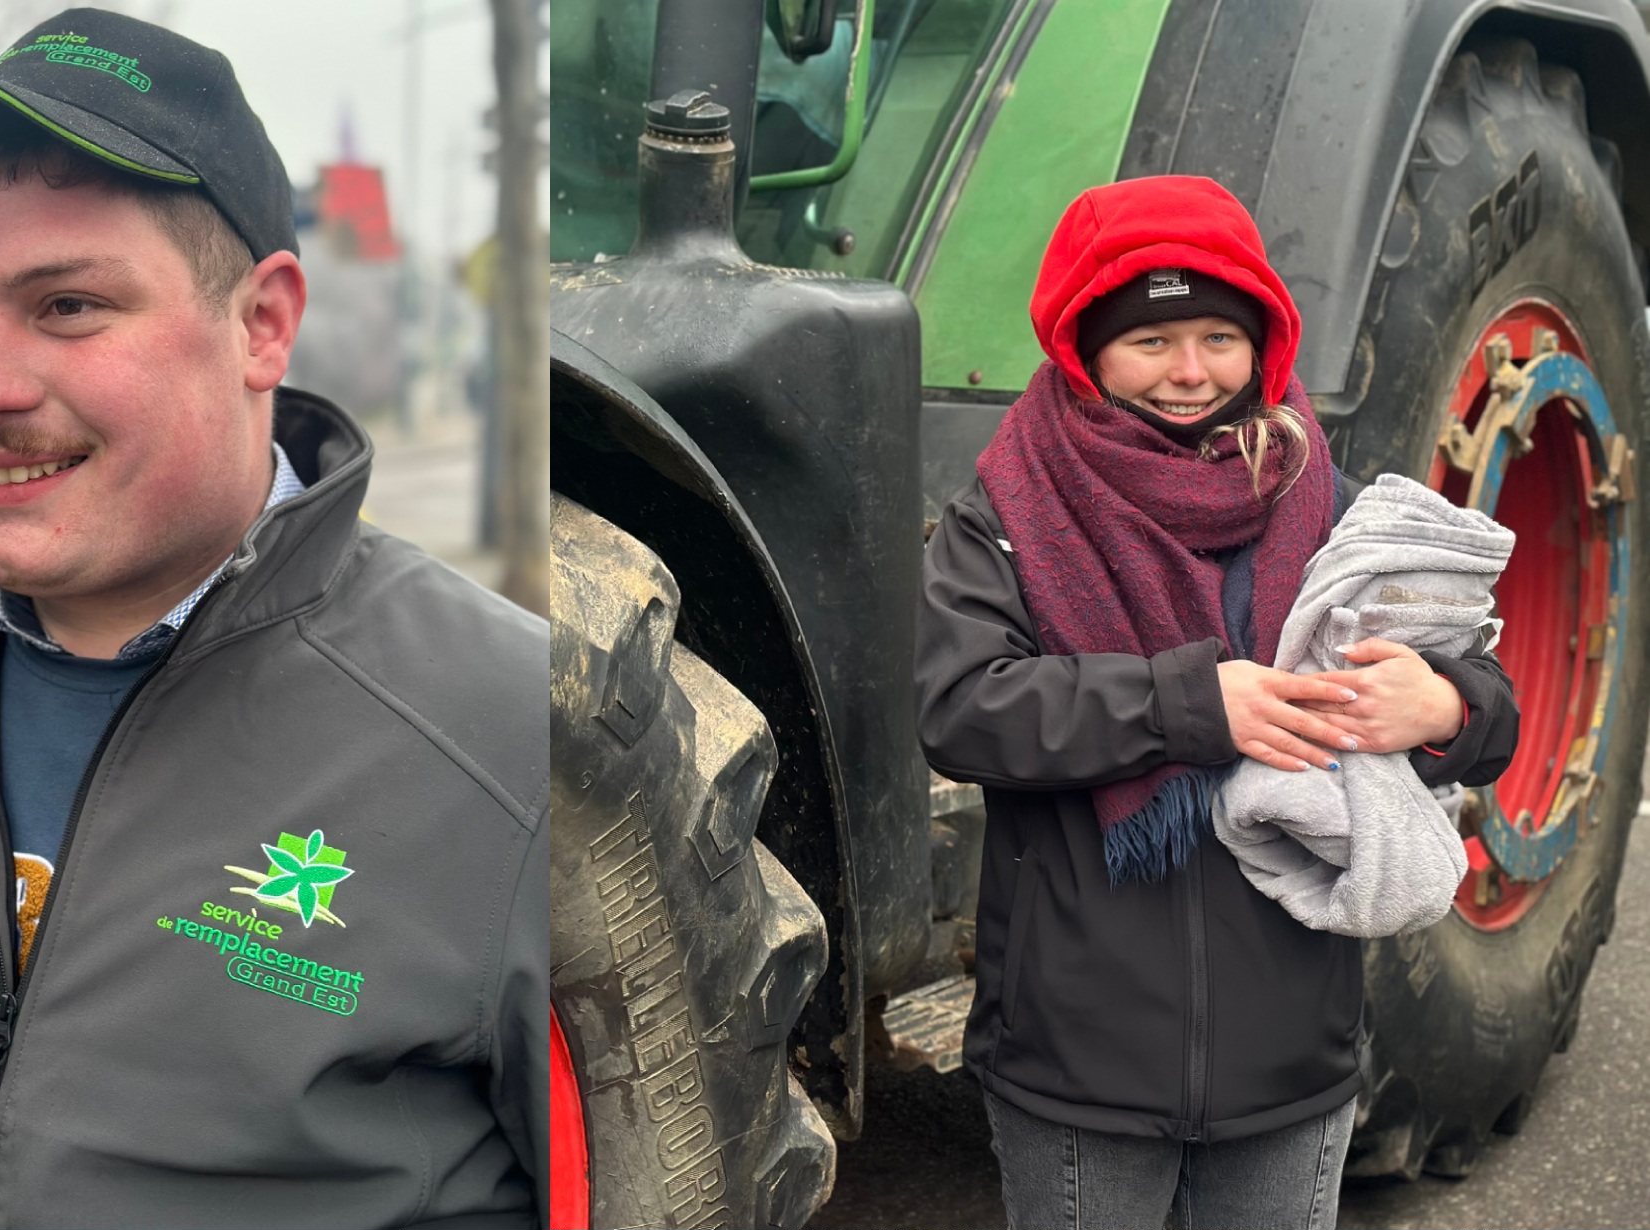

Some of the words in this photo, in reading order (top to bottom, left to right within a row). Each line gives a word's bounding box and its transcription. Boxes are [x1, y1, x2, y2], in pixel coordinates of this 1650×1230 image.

[20, 41, 140, 68] remplacement
[35, 34, 89, 44] service
[50, 52, 111, 69] Grand
[116, 66, 147, 90] Est
[201, 901, 283, 940] service
[156, 916, 174, 930] de
[174, 917, 365, 993] remplacement
[236, 962, 306, 998] Grand
[312, 988, 349, 1010] Est
